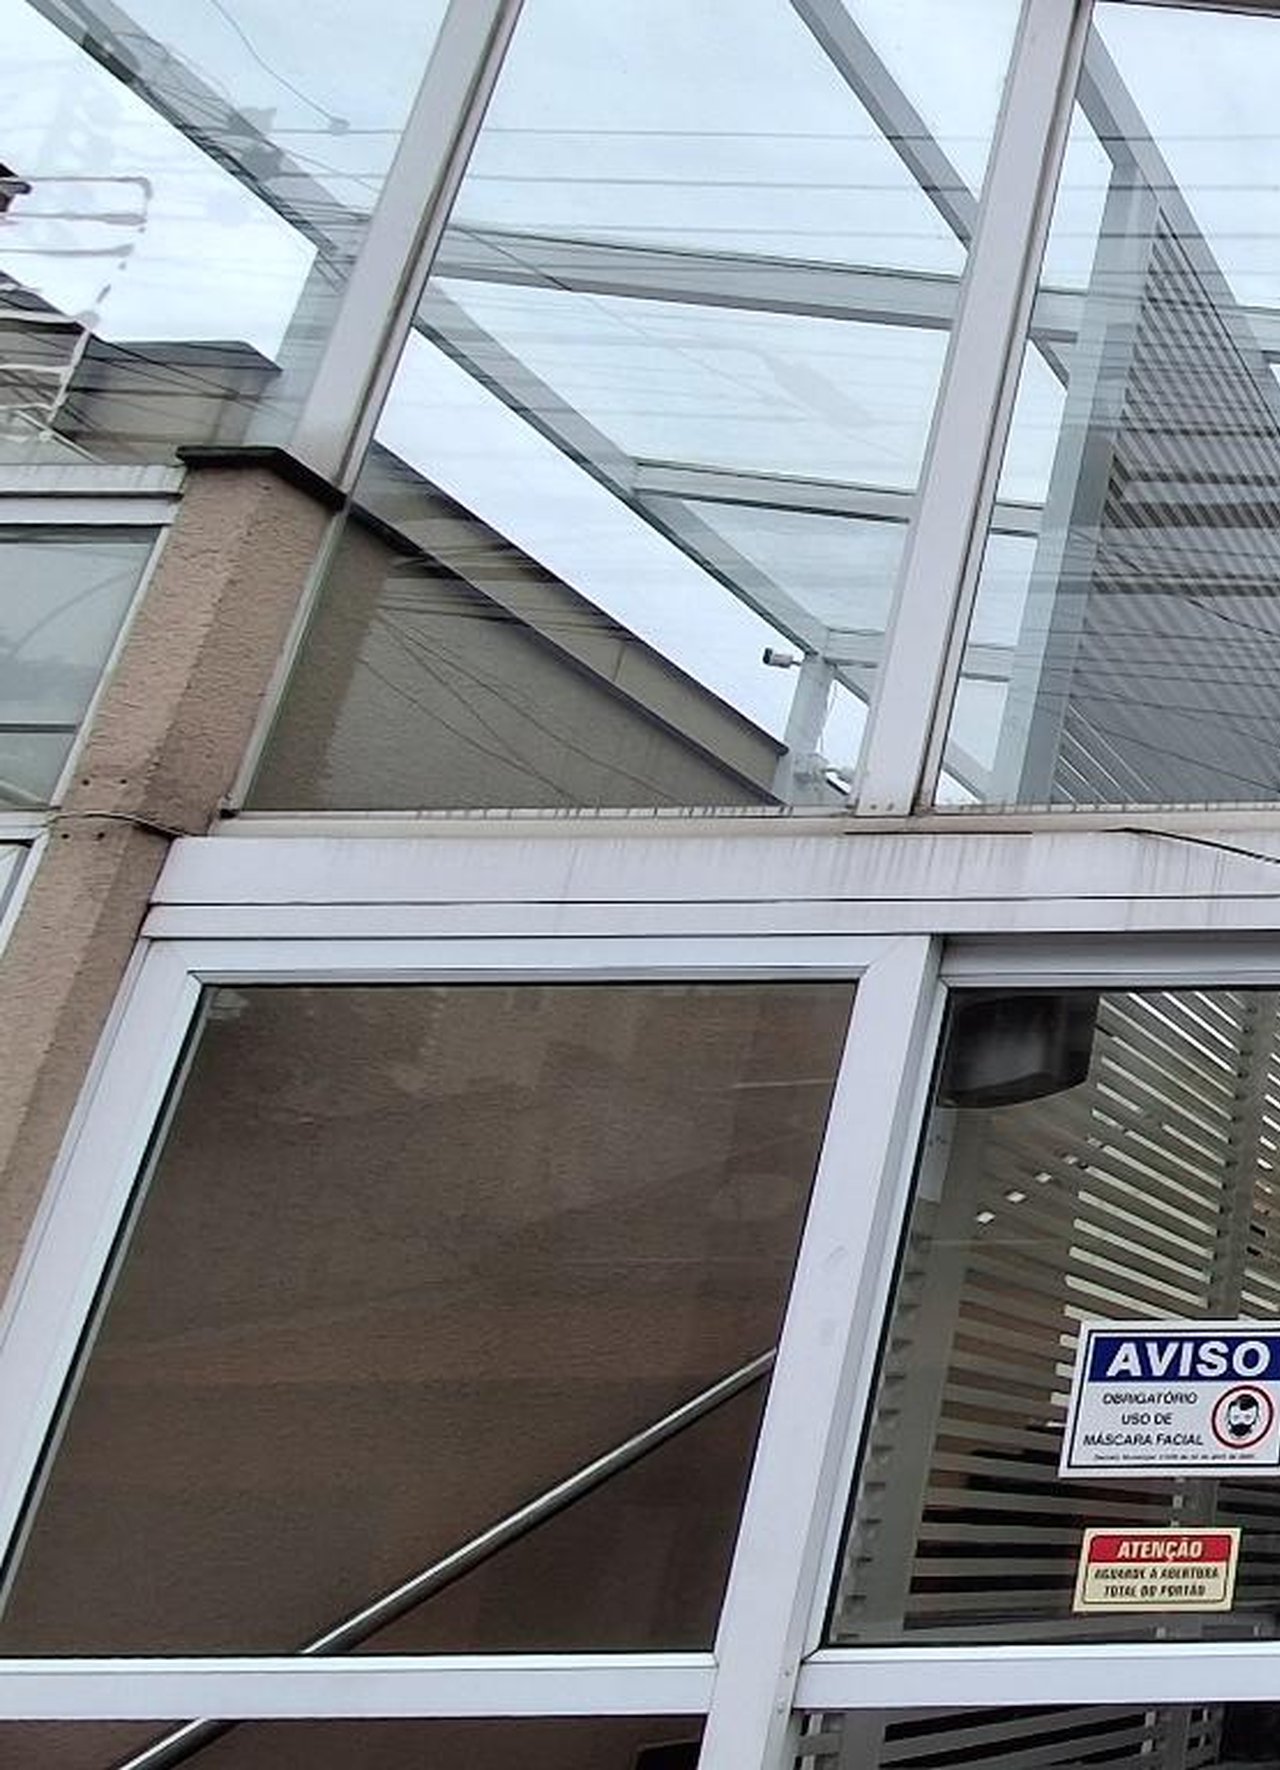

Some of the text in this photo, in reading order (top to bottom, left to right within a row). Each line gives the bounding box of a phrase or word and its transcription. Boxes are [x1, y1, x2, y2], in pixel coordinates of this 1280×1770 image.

[1105, 1339, 1272, 1378] AVISO
[1102, 1391, 1199, 1405] OBRIGATÓRIO
[1121, 1412, 1174, 1426] USO DE
[1155, 1432, 1205, 1447] FACIAL
[1116, 1537, 1204, 1561] ATENÇÃO
